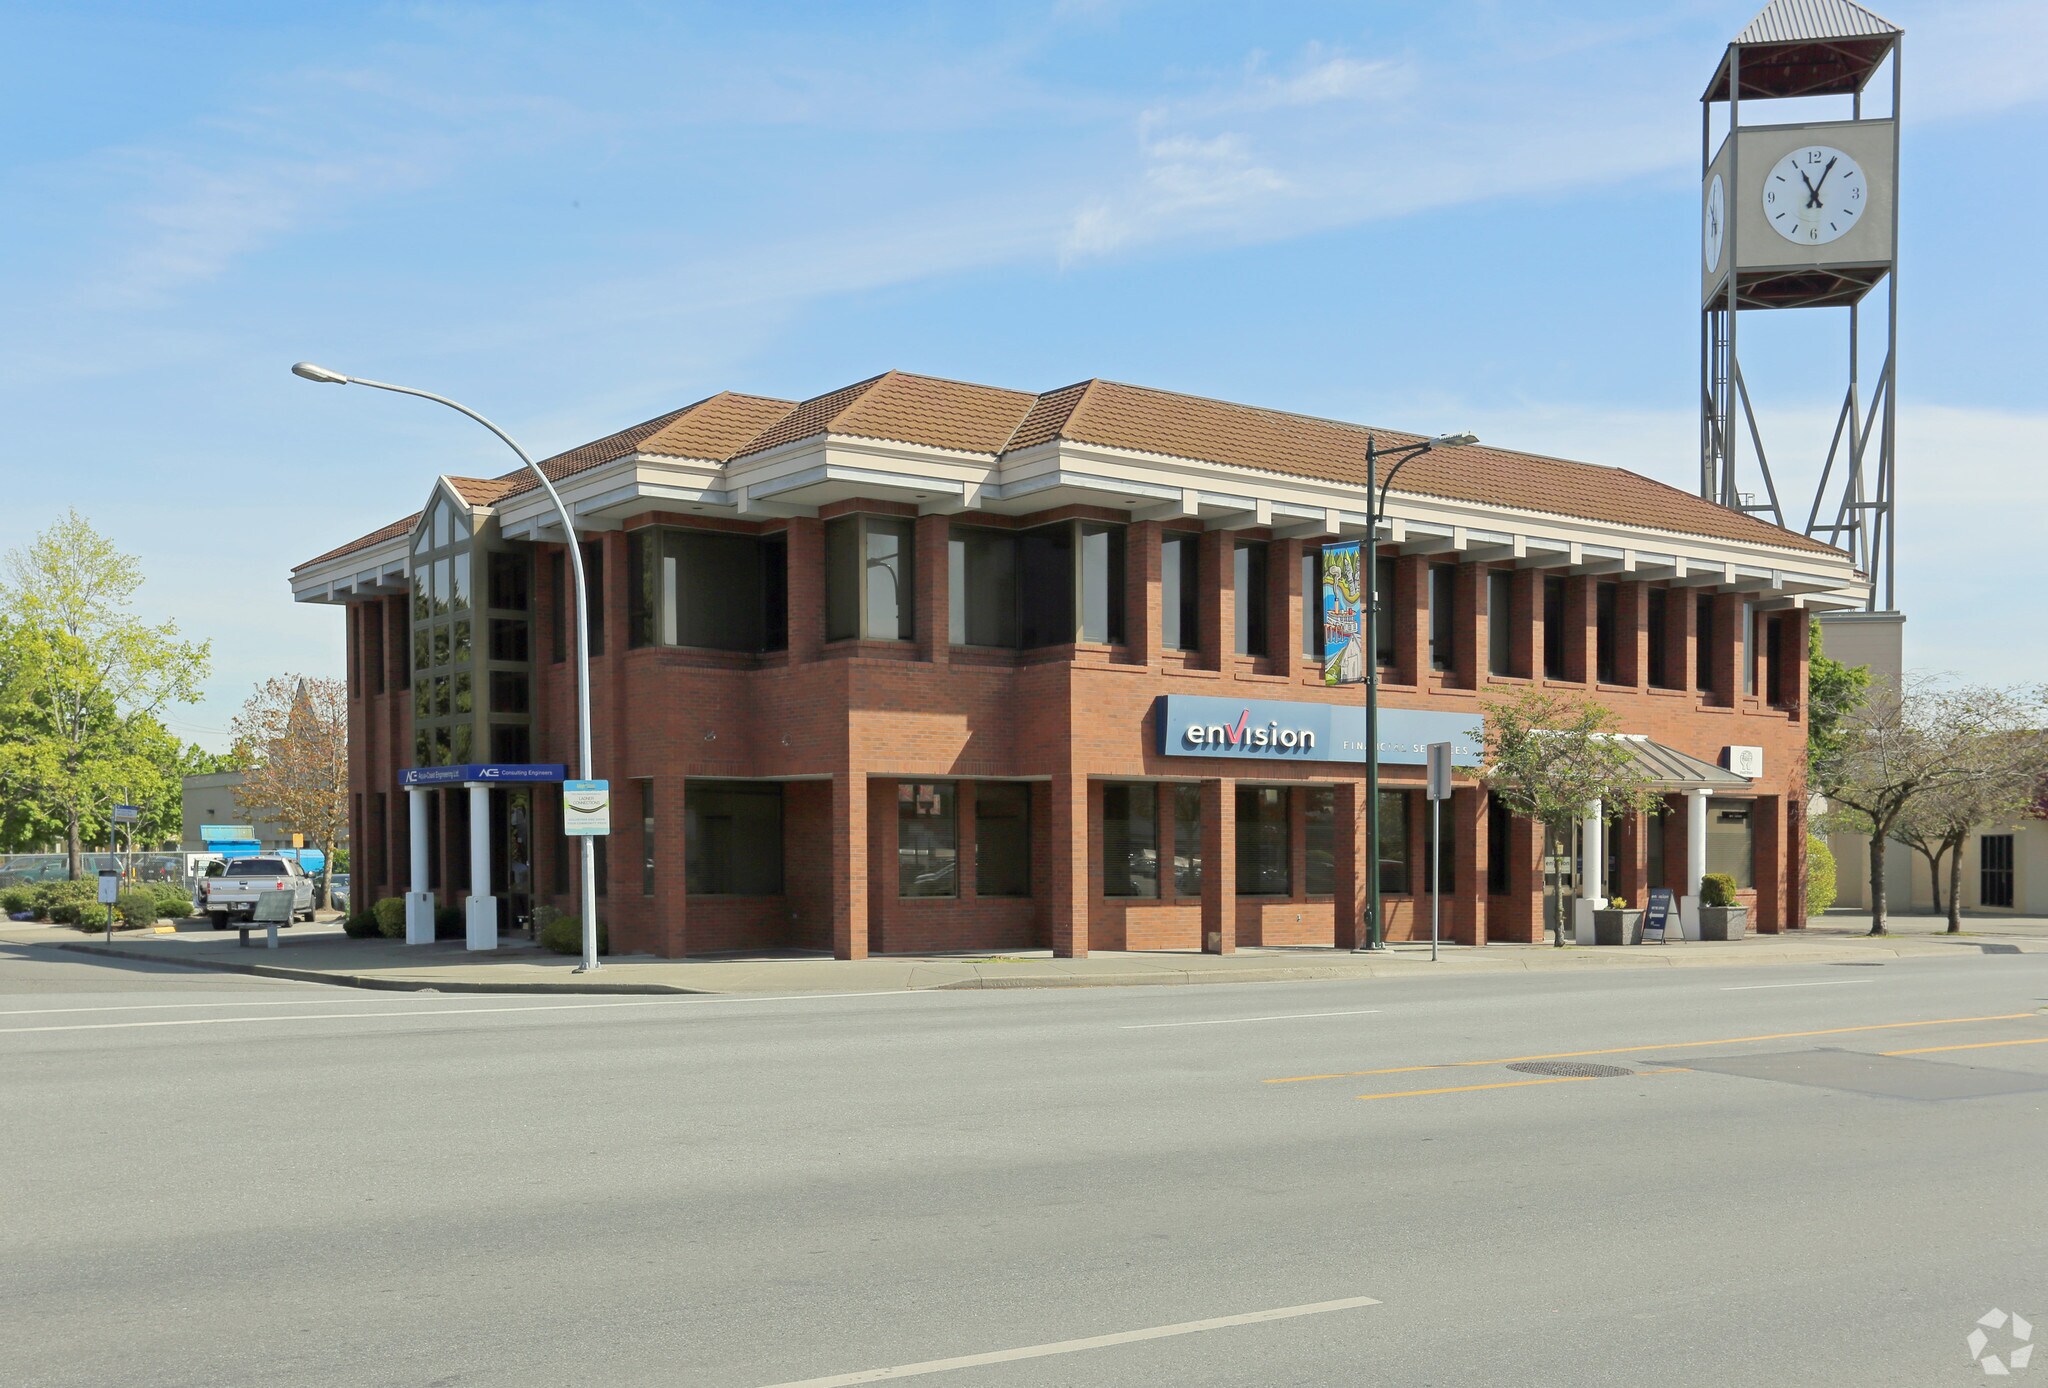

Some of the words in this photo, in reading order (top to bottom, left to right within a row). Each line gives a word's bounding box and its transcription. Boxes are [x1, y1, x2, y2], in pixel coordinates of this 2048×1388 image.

[1807, 150, 1822, 164] 12
[1767, 191, 1776, 204] 9
[1851, 187, 1860, 200] 3
[1809, 228, 1818, 240] 6
[1186, 708, 1316, 749] envision
[501, 769, 527, 777] Consulting
[528, 769, 553, 777] Engineers
